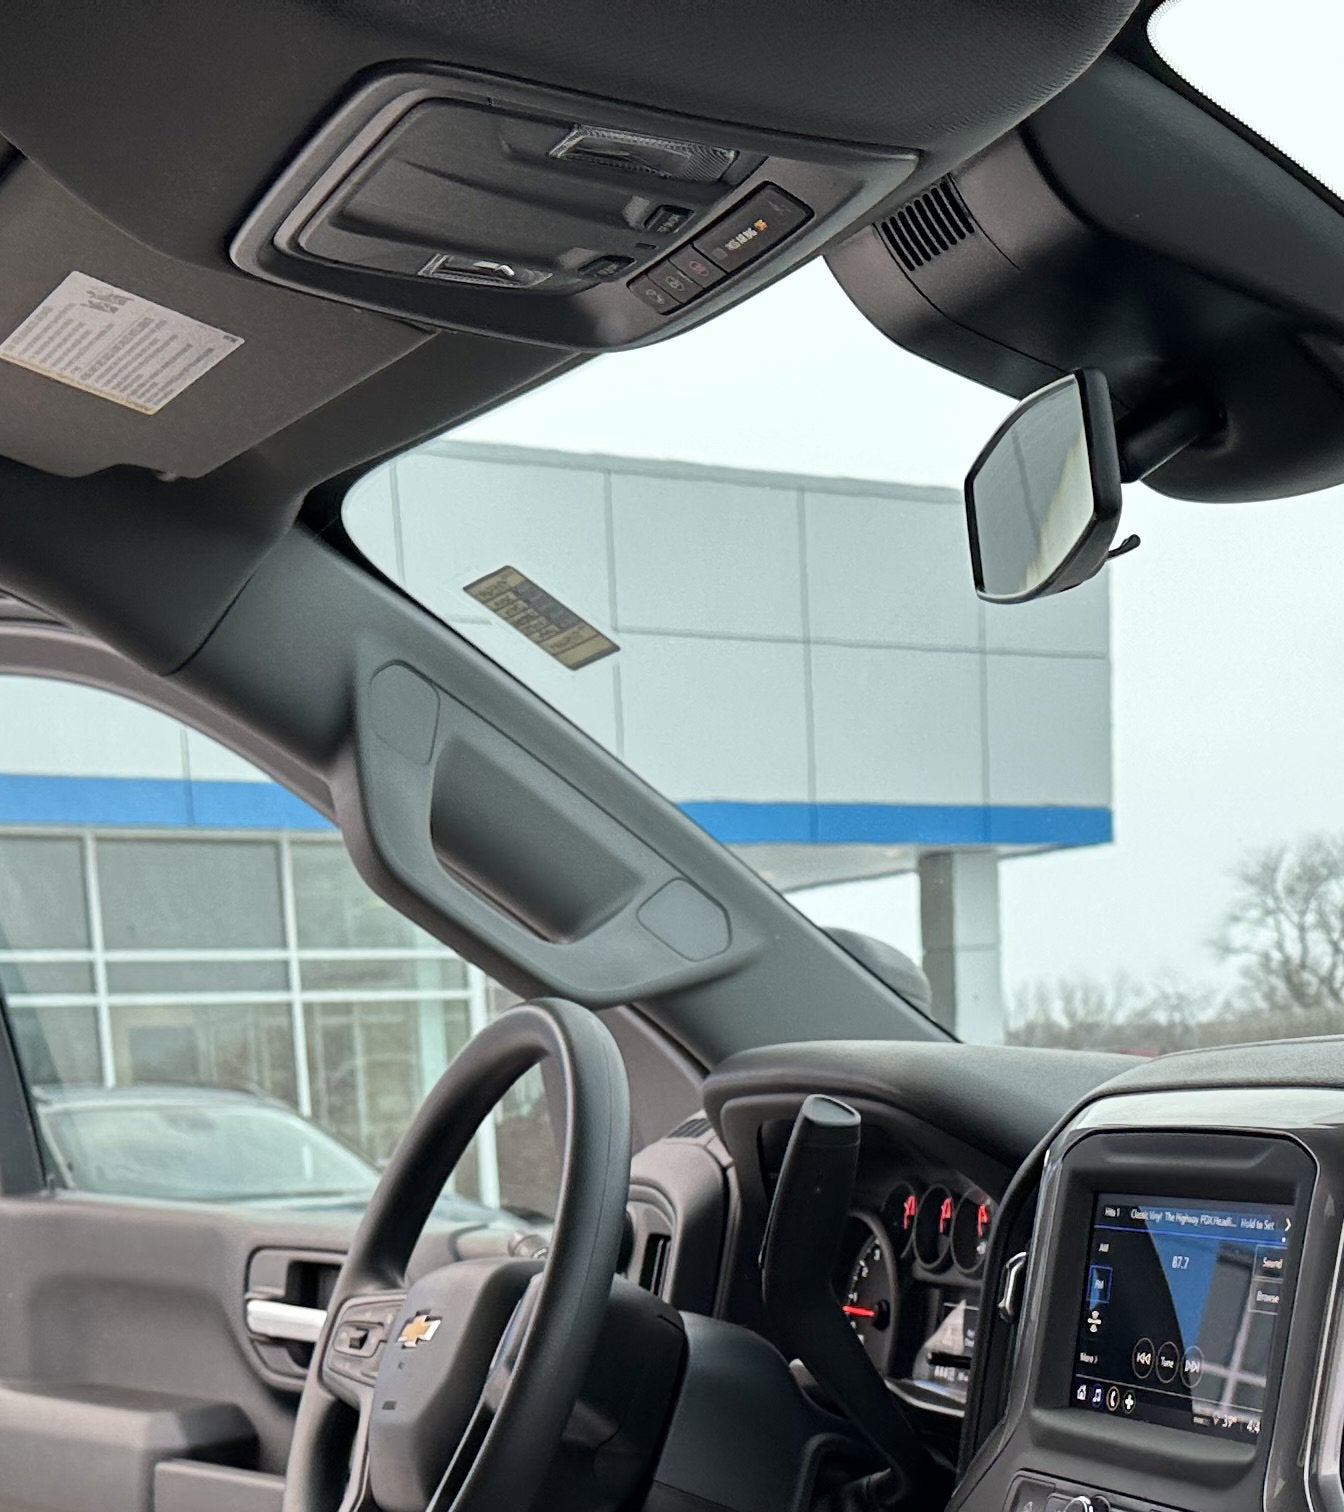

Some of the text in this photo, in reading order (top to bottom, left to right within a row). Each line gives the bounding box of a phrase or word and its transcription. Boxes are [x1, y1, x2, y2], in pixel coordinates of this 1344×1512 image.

[1240, 1218, 1256, 1229] Hold
[1263, 1219, 1275, 1231] Set
[1171, 1255, 1190, 1269] 87.7
